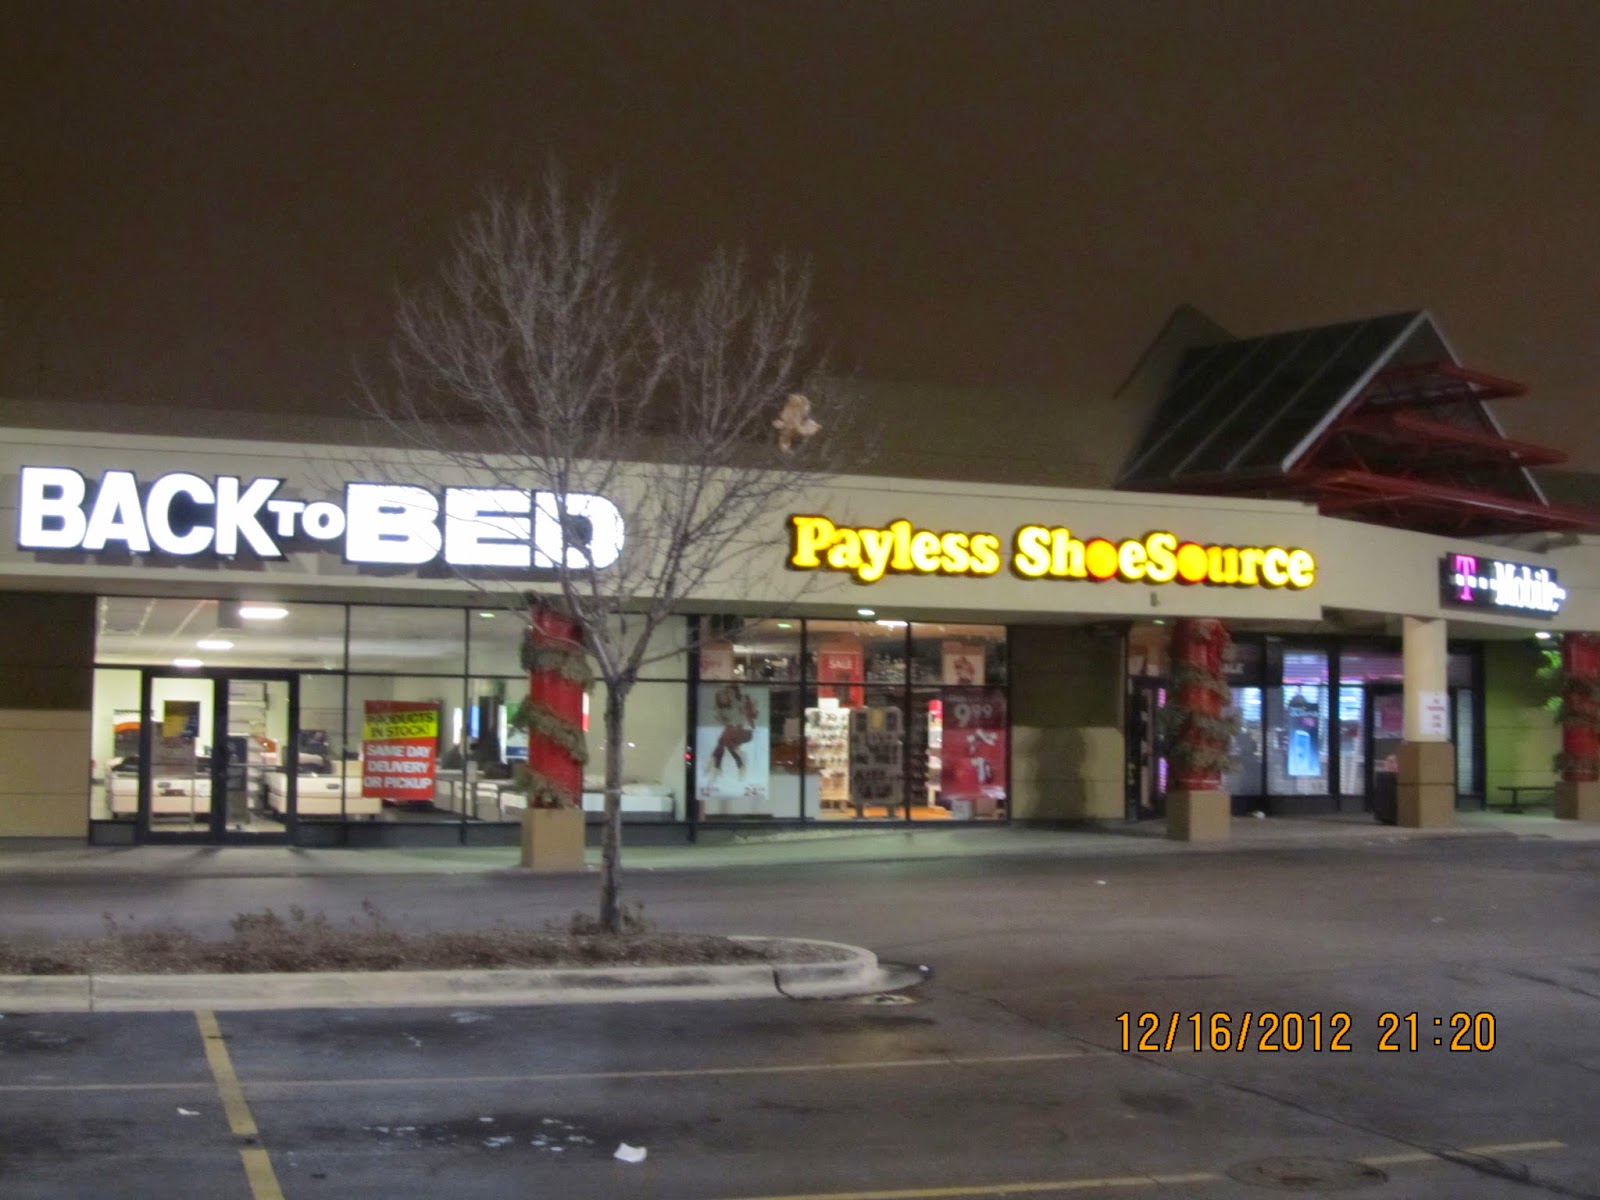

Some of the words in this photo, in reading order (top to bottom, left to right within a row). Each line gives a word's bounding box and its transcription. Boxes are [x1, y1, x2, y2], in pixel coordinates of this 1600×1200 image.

[19, 466, 284, 559] BACK
[267, 500, 346, 540] TO
[344, 482, 626, 570] BED
[790, 515, 1003, 583] Payless
[1013, 524, 1317, 589] ShoeSource
[367, 712, 434, 725] PRODUCTS
[370, 726, 384, 738] IN
[366, 743, 405, 757] SAME
[406, 745, 432, 758] DAY
[367, 761, 430, 774] DELIVERY
[364, 776, 382, 788] OR
[383, 776, 432, 790] PICKUP
